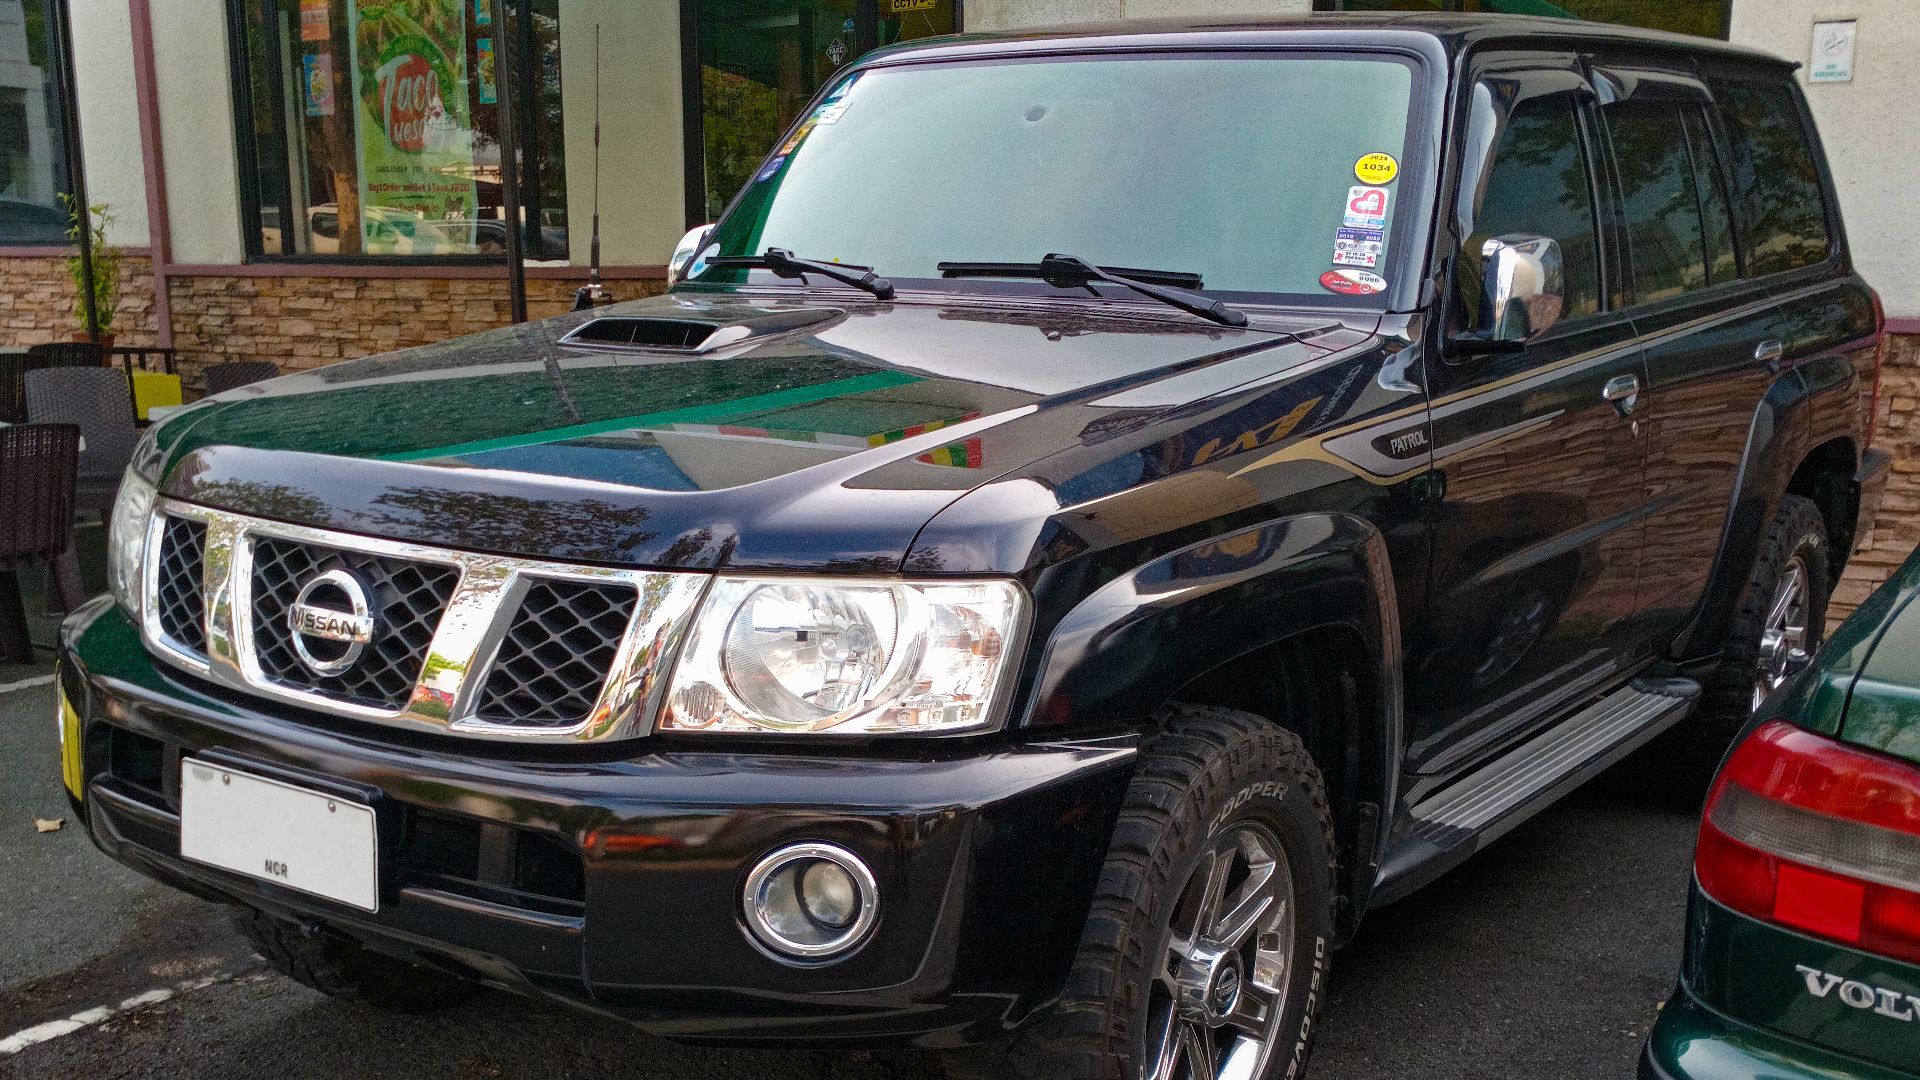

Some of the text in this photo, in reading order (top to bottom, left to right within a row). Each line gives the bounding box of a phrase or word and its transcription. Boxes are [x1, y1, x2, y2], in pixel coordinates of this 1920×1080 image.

[893, 0, 917, 9] CCTV
[1814, 70, 1849, 78] SMOKING
[1362, 163, 1391, 172] 1034
[1390, 429, 1429, 455] PATROL
[290, 607, 358, 636] NISSAN
[1206, 780, 1290, 839] COOPER
[265, 858, 288, 877] NCR
